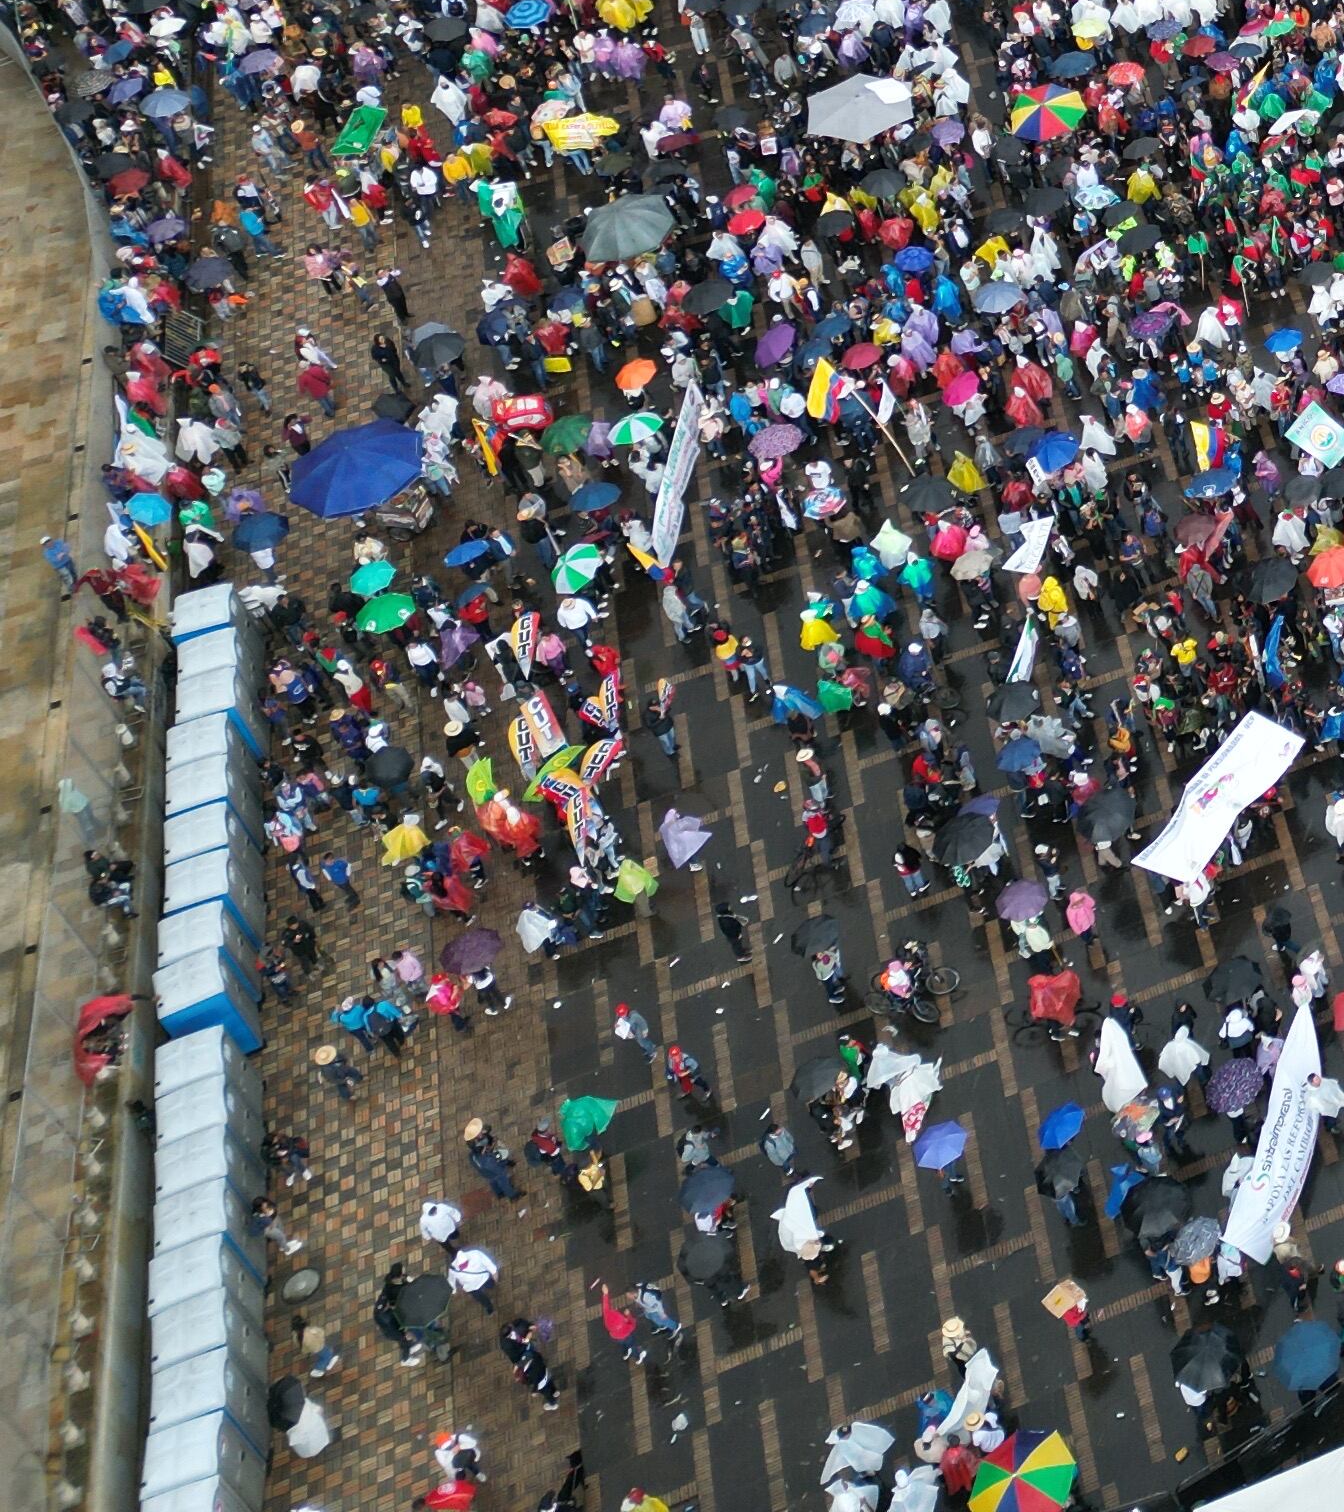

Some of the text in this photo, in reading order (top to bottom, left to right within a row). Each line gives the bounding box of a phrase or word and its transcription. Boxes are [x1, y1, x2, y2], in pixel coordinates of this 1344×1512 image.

[518, 616, 535, 658] CUT
[527, 696, 553, 741] CUT
[604, 676, 618, 723] CUT
[516, 715, 535, 763] CUT
[585, 741, 616, 779] CUT
